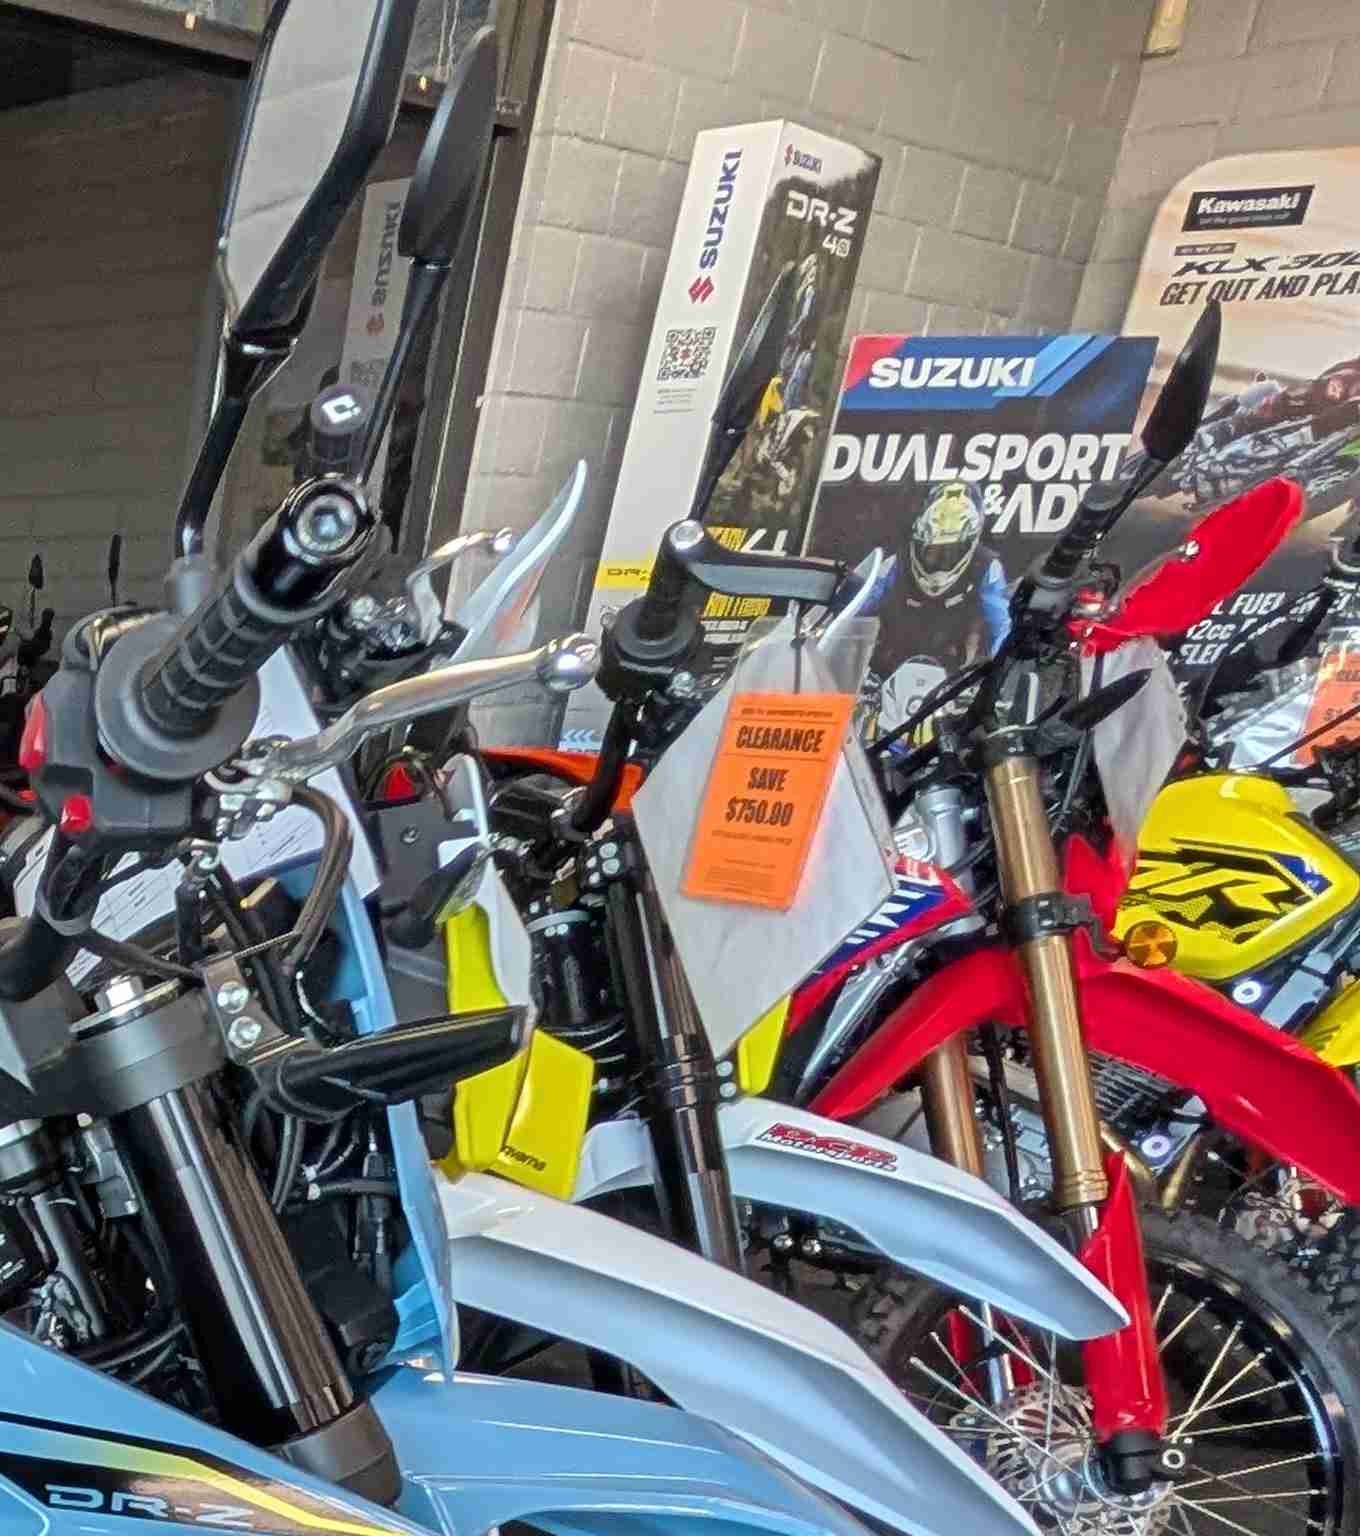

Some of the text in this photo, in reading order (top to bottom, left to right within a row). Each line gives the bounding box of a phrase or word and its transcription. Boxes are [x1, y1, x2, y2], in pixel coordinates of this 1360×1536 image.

[699, 147, 744, 270] SUZUKI
[1196, 192, 1302, 215] Kawasaki
[1172, 256, 1280, 278] KLX
[1159, 281, 1208, 306] GET
[1205, 277, 1260, 303] OUT
[1254, 274, 1311, 301] AND
[868, 356, 1038, 389] SUZUKI
[821, 433, 1133, 483] DUALSPORT
[736, 724, 826, 753] CLEARANCE
[747, 766, 790, 791] SAVE
[725, 795, 795, 827] $750.00
[44, 1483, 257, 1529] DR-Z
